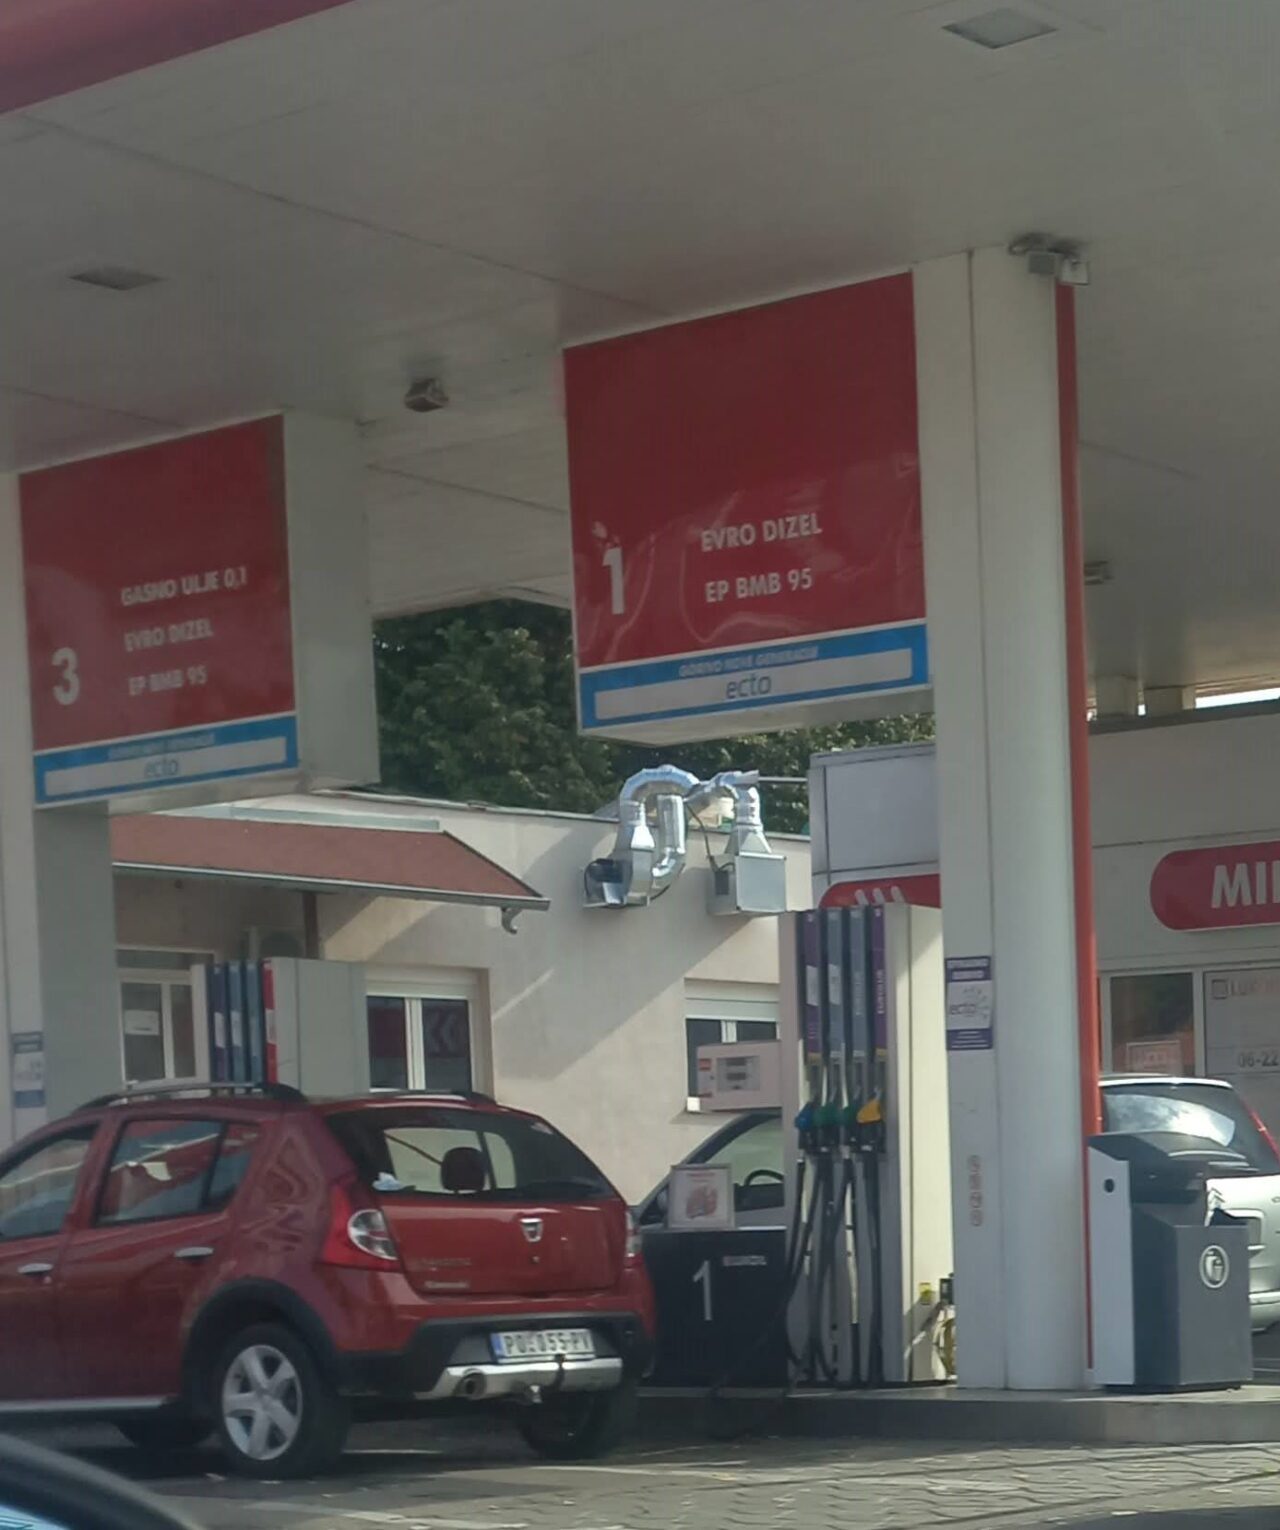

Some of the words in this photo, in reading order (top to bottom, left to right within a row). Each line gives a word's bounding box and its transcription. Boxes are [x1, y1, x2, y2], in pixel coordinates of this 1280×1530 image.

[701, 523, 757, 552] EVRO
[762, 513, 823, 542] DIZEL
[181, 571, 219, 595] ULJE
[602, 546, 625, 615] 1
[705, 580, 729, 603] EP
[735, 572, 781, 599] BMB
[787, 567, 813, 592] 95
[52, 647, 81, 706] 3
[726, 674, 773, 700] ecto
[693, 1260, 712, 1321] 1
